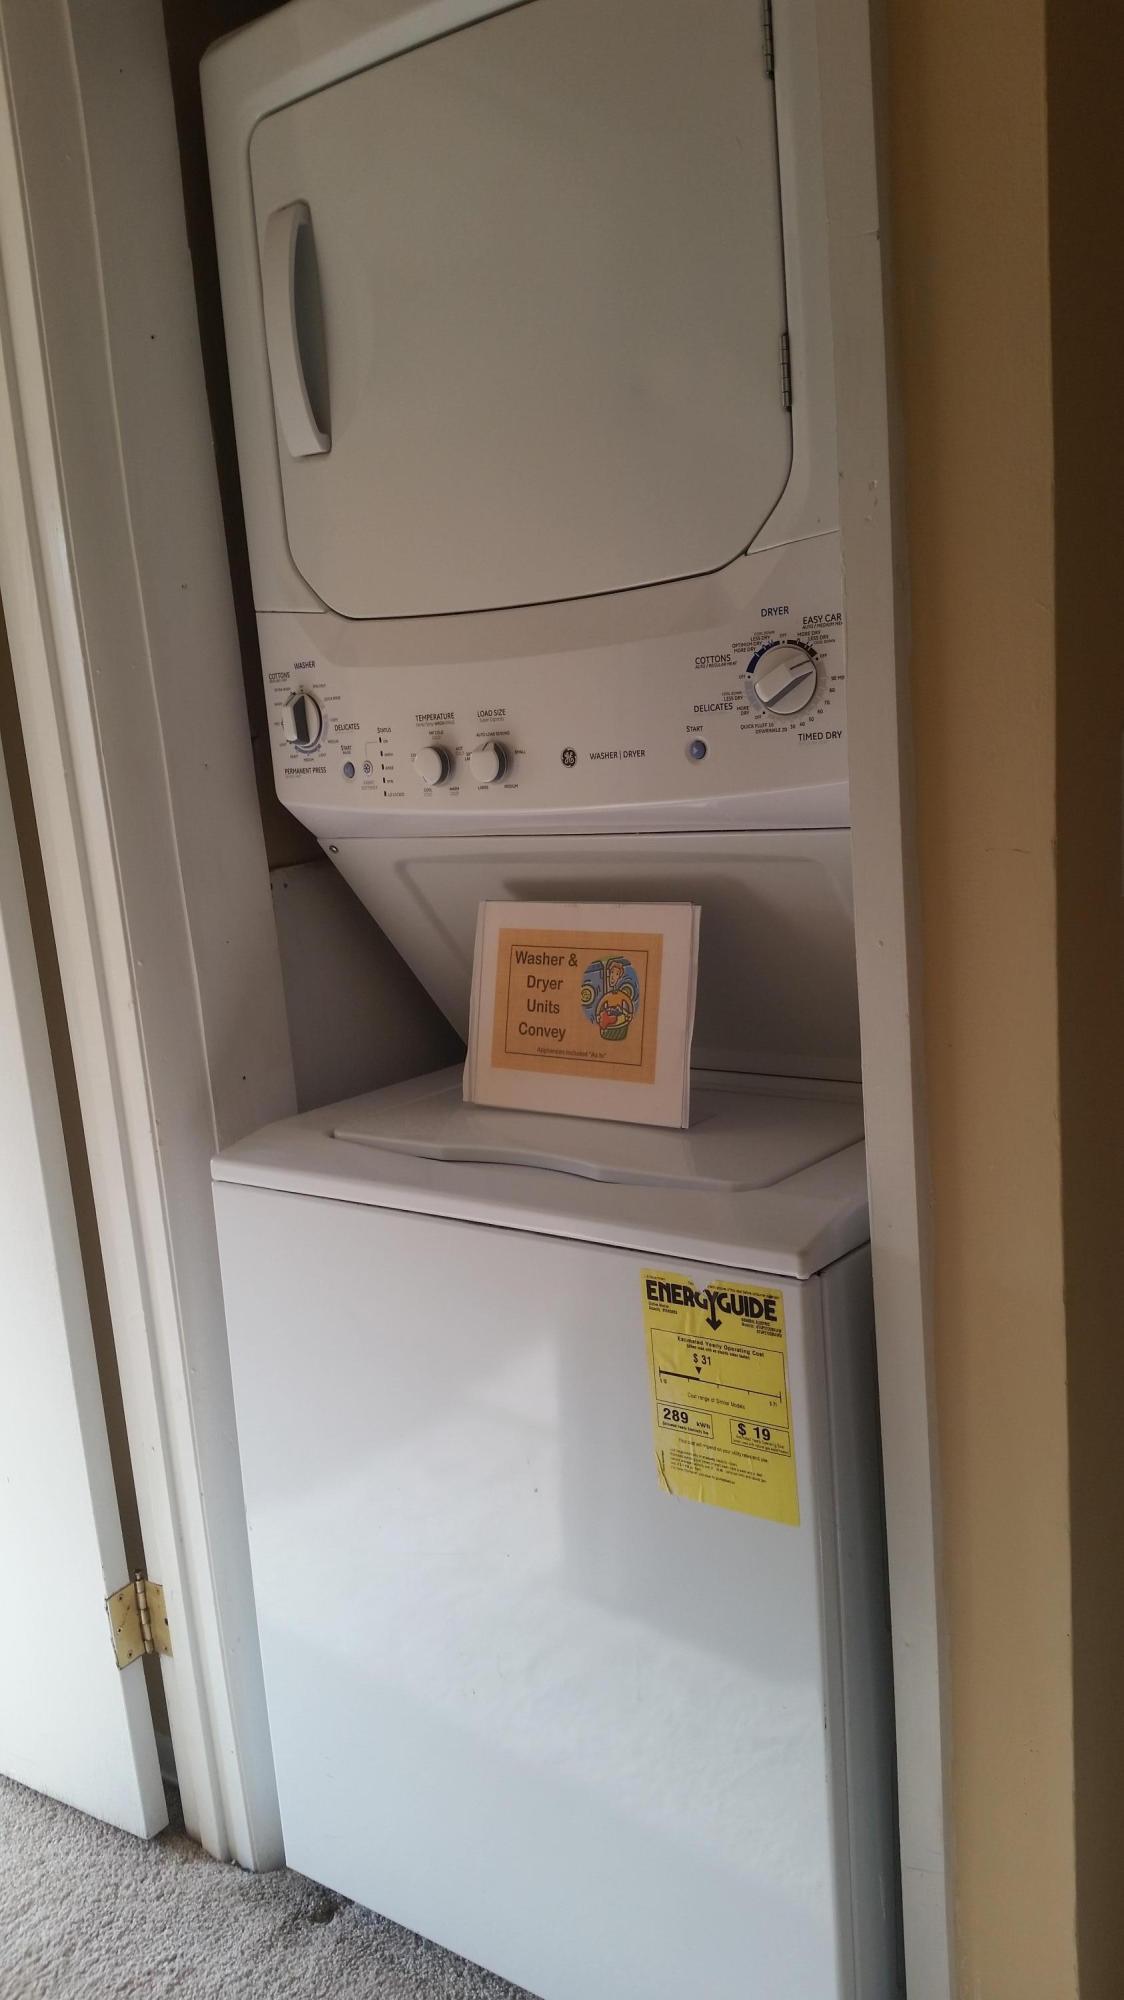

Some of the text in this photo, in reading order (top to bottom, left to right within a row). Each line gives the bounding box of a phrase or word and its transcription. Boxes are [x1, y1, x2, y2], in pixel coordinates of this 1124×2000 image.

[761, 606, 789, 617] DRYER
[803, 613, 842, 625] EASY CAR
[695, 654, 731, 665] COTTONS
[294, 661, 315, 670] WASHER
[268, 672, 290, 680] COTTONS
[477, 708, 506, 718] LOAD SIZE
[694, 703, 733, 713] DELICATES
[415, 712, 455, 722] TEMPERATURE
[334, 723, 360, 732] DELICATES
[799, 731, 842, 741] TIMED DRY
[590, 751, 618, 760] WASHER
[623, 750, 646, 759] DRYER
[284, 766, 326, 775] PERMANENT PRESS
[515, 950, 578, 967] Washer &
[527, 975, 563, 992] Dryer
[527, 999, 560, 1014] Units
[518, 1022, 566, 1042] Convey
[646, 1279, 777, 1322] ENERGYGUIDE
[677, 1336, 765, 1358] Estimated Yearly Operating Cost
[693, 1353, 711, 1365] $ 31
[663, 1407, 689, 1424] 289
[737, 1423, 771, 1441] $ 19
